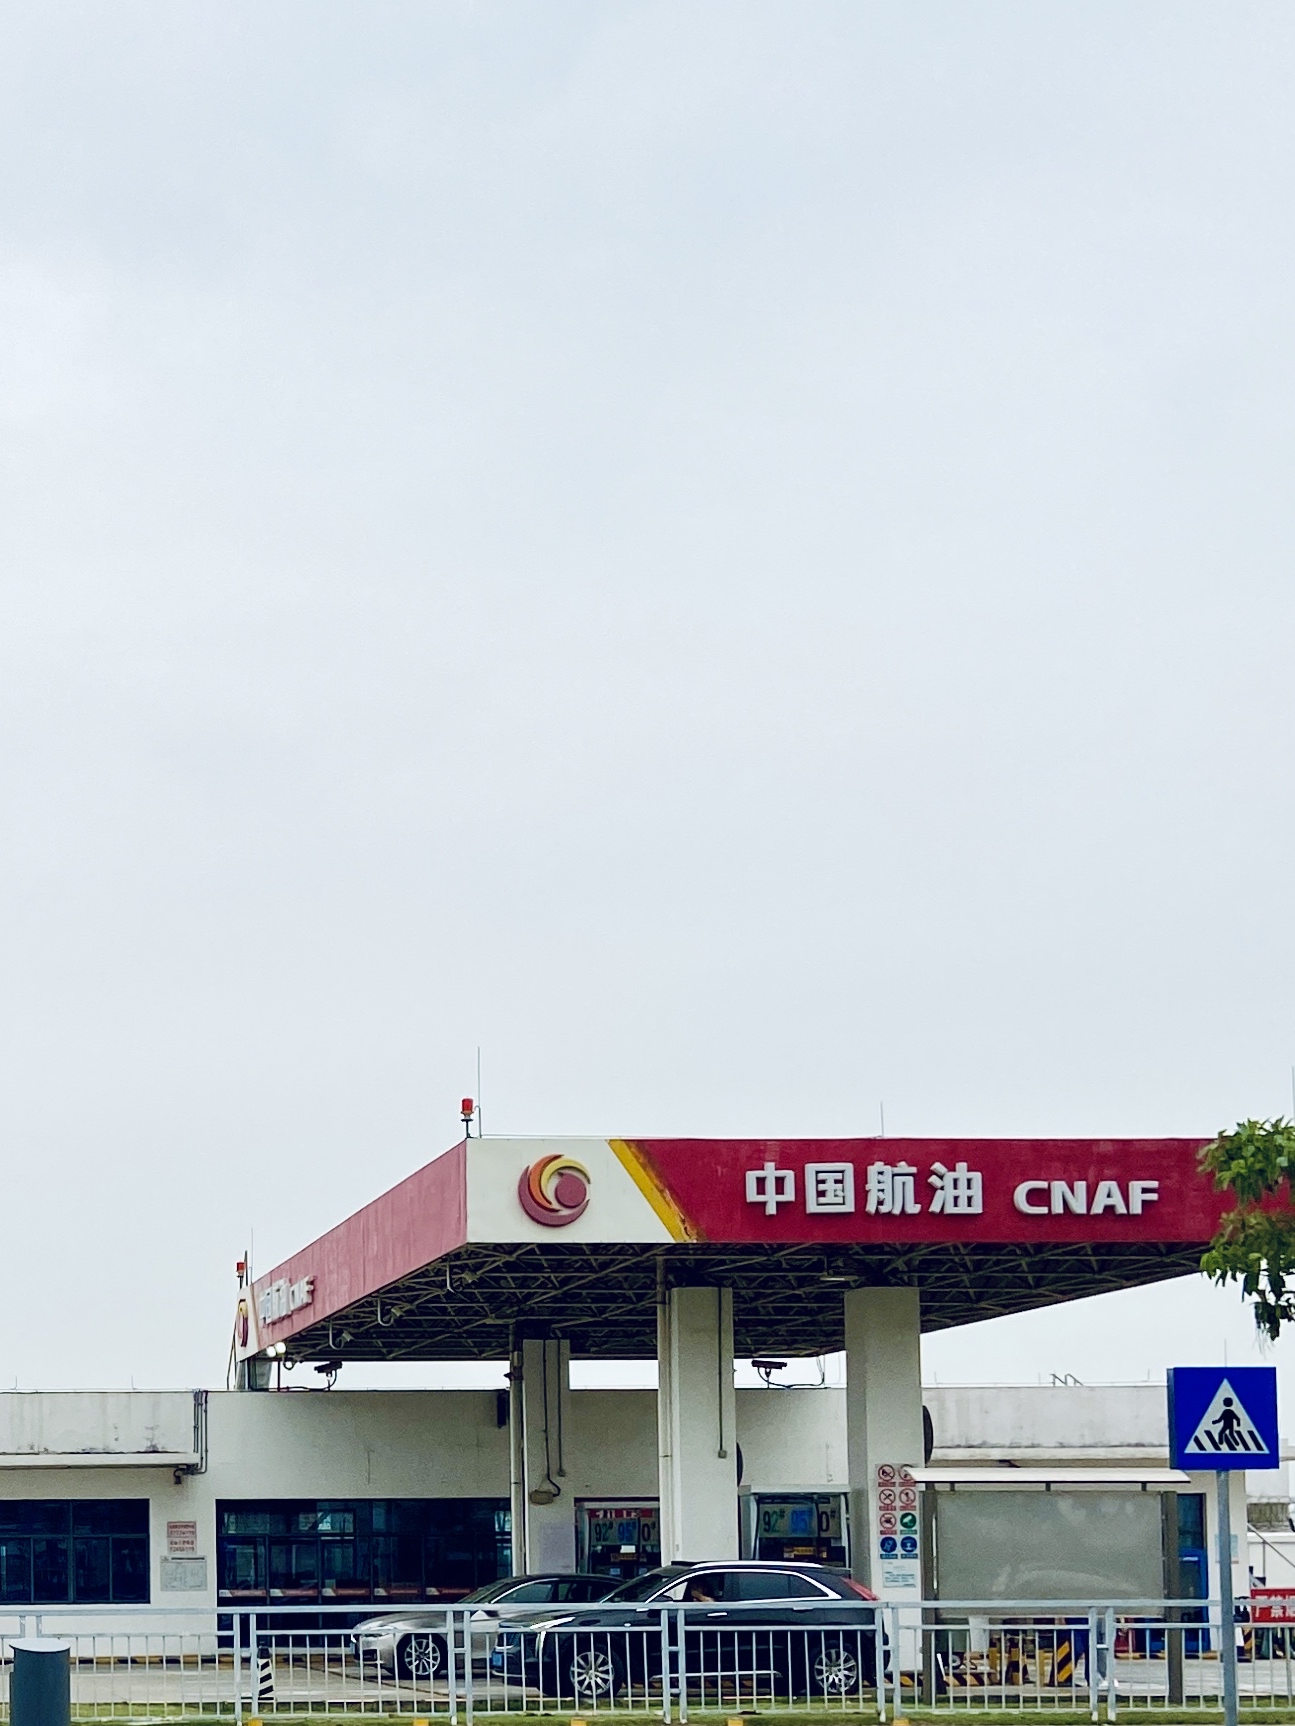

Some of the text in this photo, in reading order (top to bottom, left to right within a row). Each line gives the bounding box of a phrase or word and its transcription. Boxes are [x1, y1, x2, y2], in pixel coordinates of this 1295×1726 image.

[745, 1161, 984, 1216] 中国航油
[1013, 1179, 1160, 1216] CNAF
